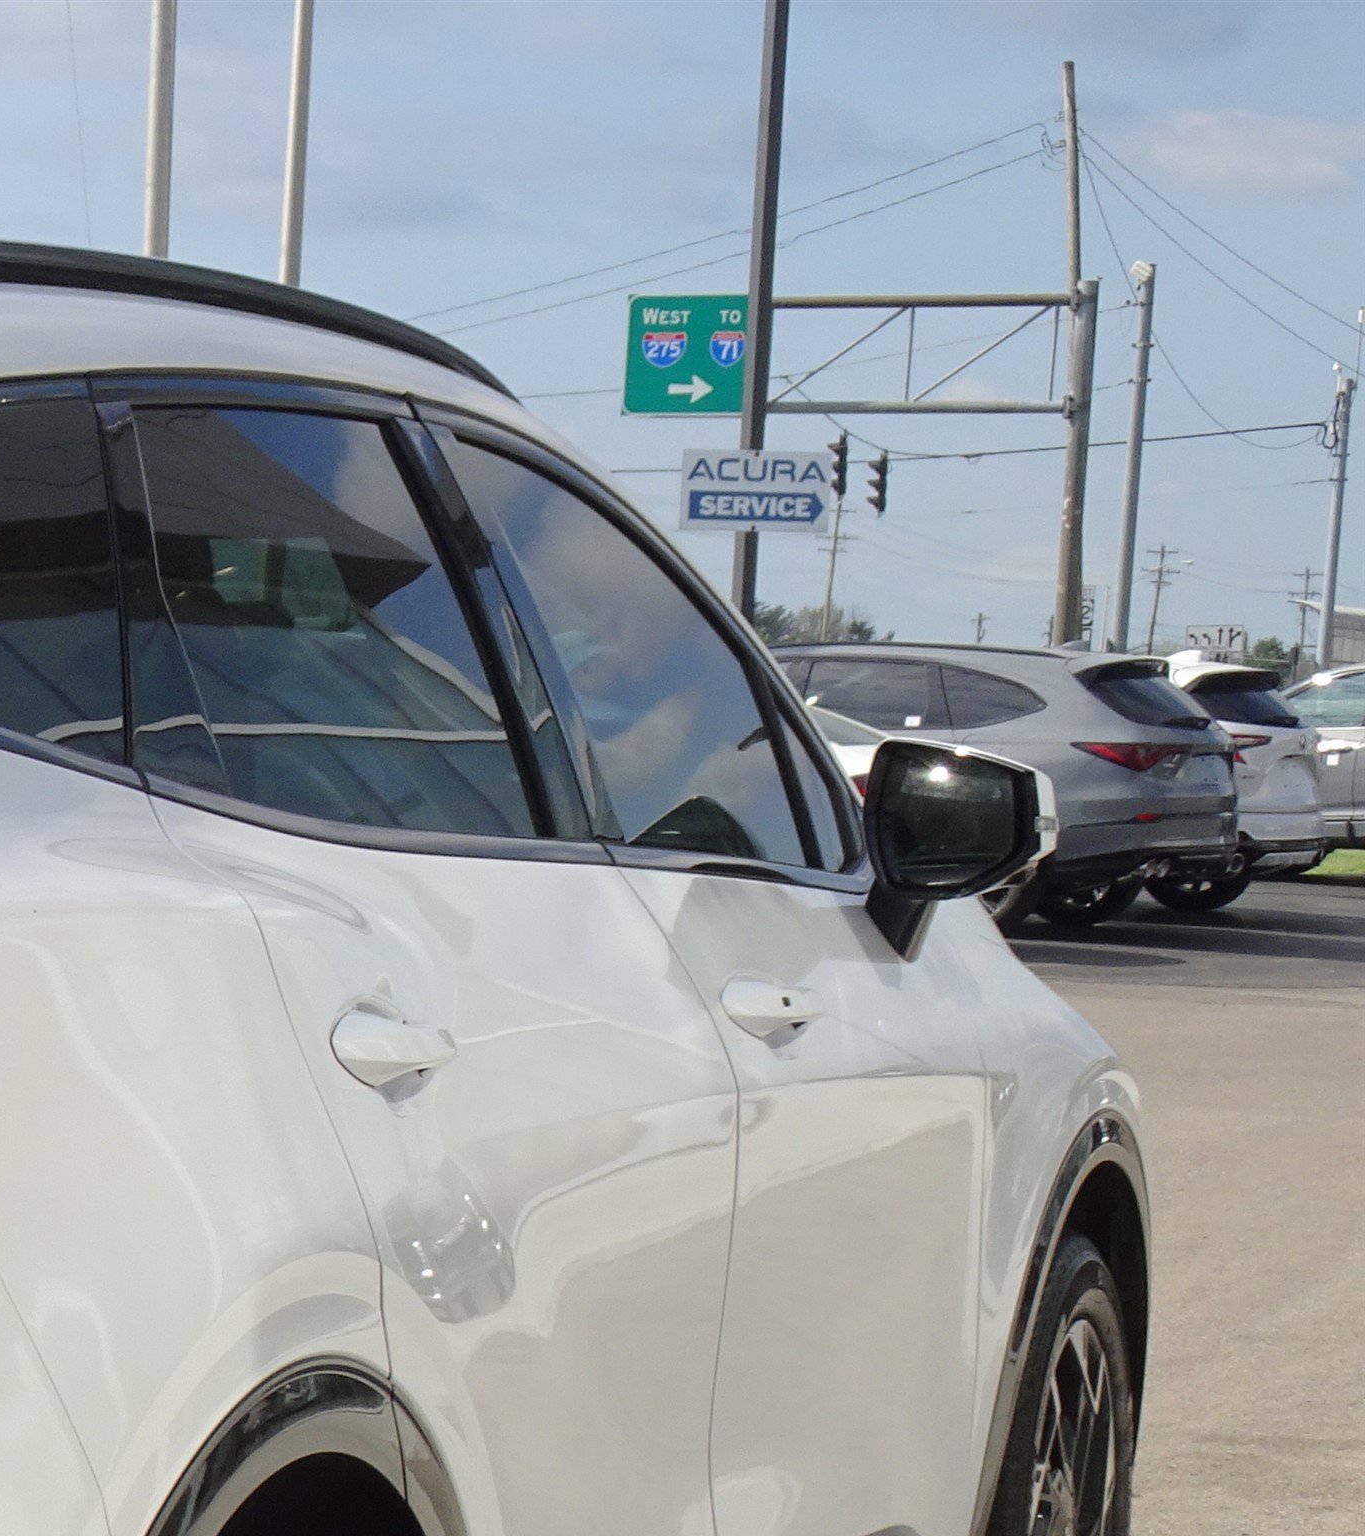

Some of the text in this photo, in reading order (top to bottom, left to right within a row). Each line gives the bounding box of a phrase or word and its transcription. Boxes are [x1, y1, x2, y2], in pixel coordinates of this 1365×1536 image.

[642, 307, 742, 325] WEST TO
[646, 341, 681, 359] 275
[718, 340, 739, 360] 71
[687, 457, 826, 483] ACURA
[698, 495, 812, 518] SERVICE
